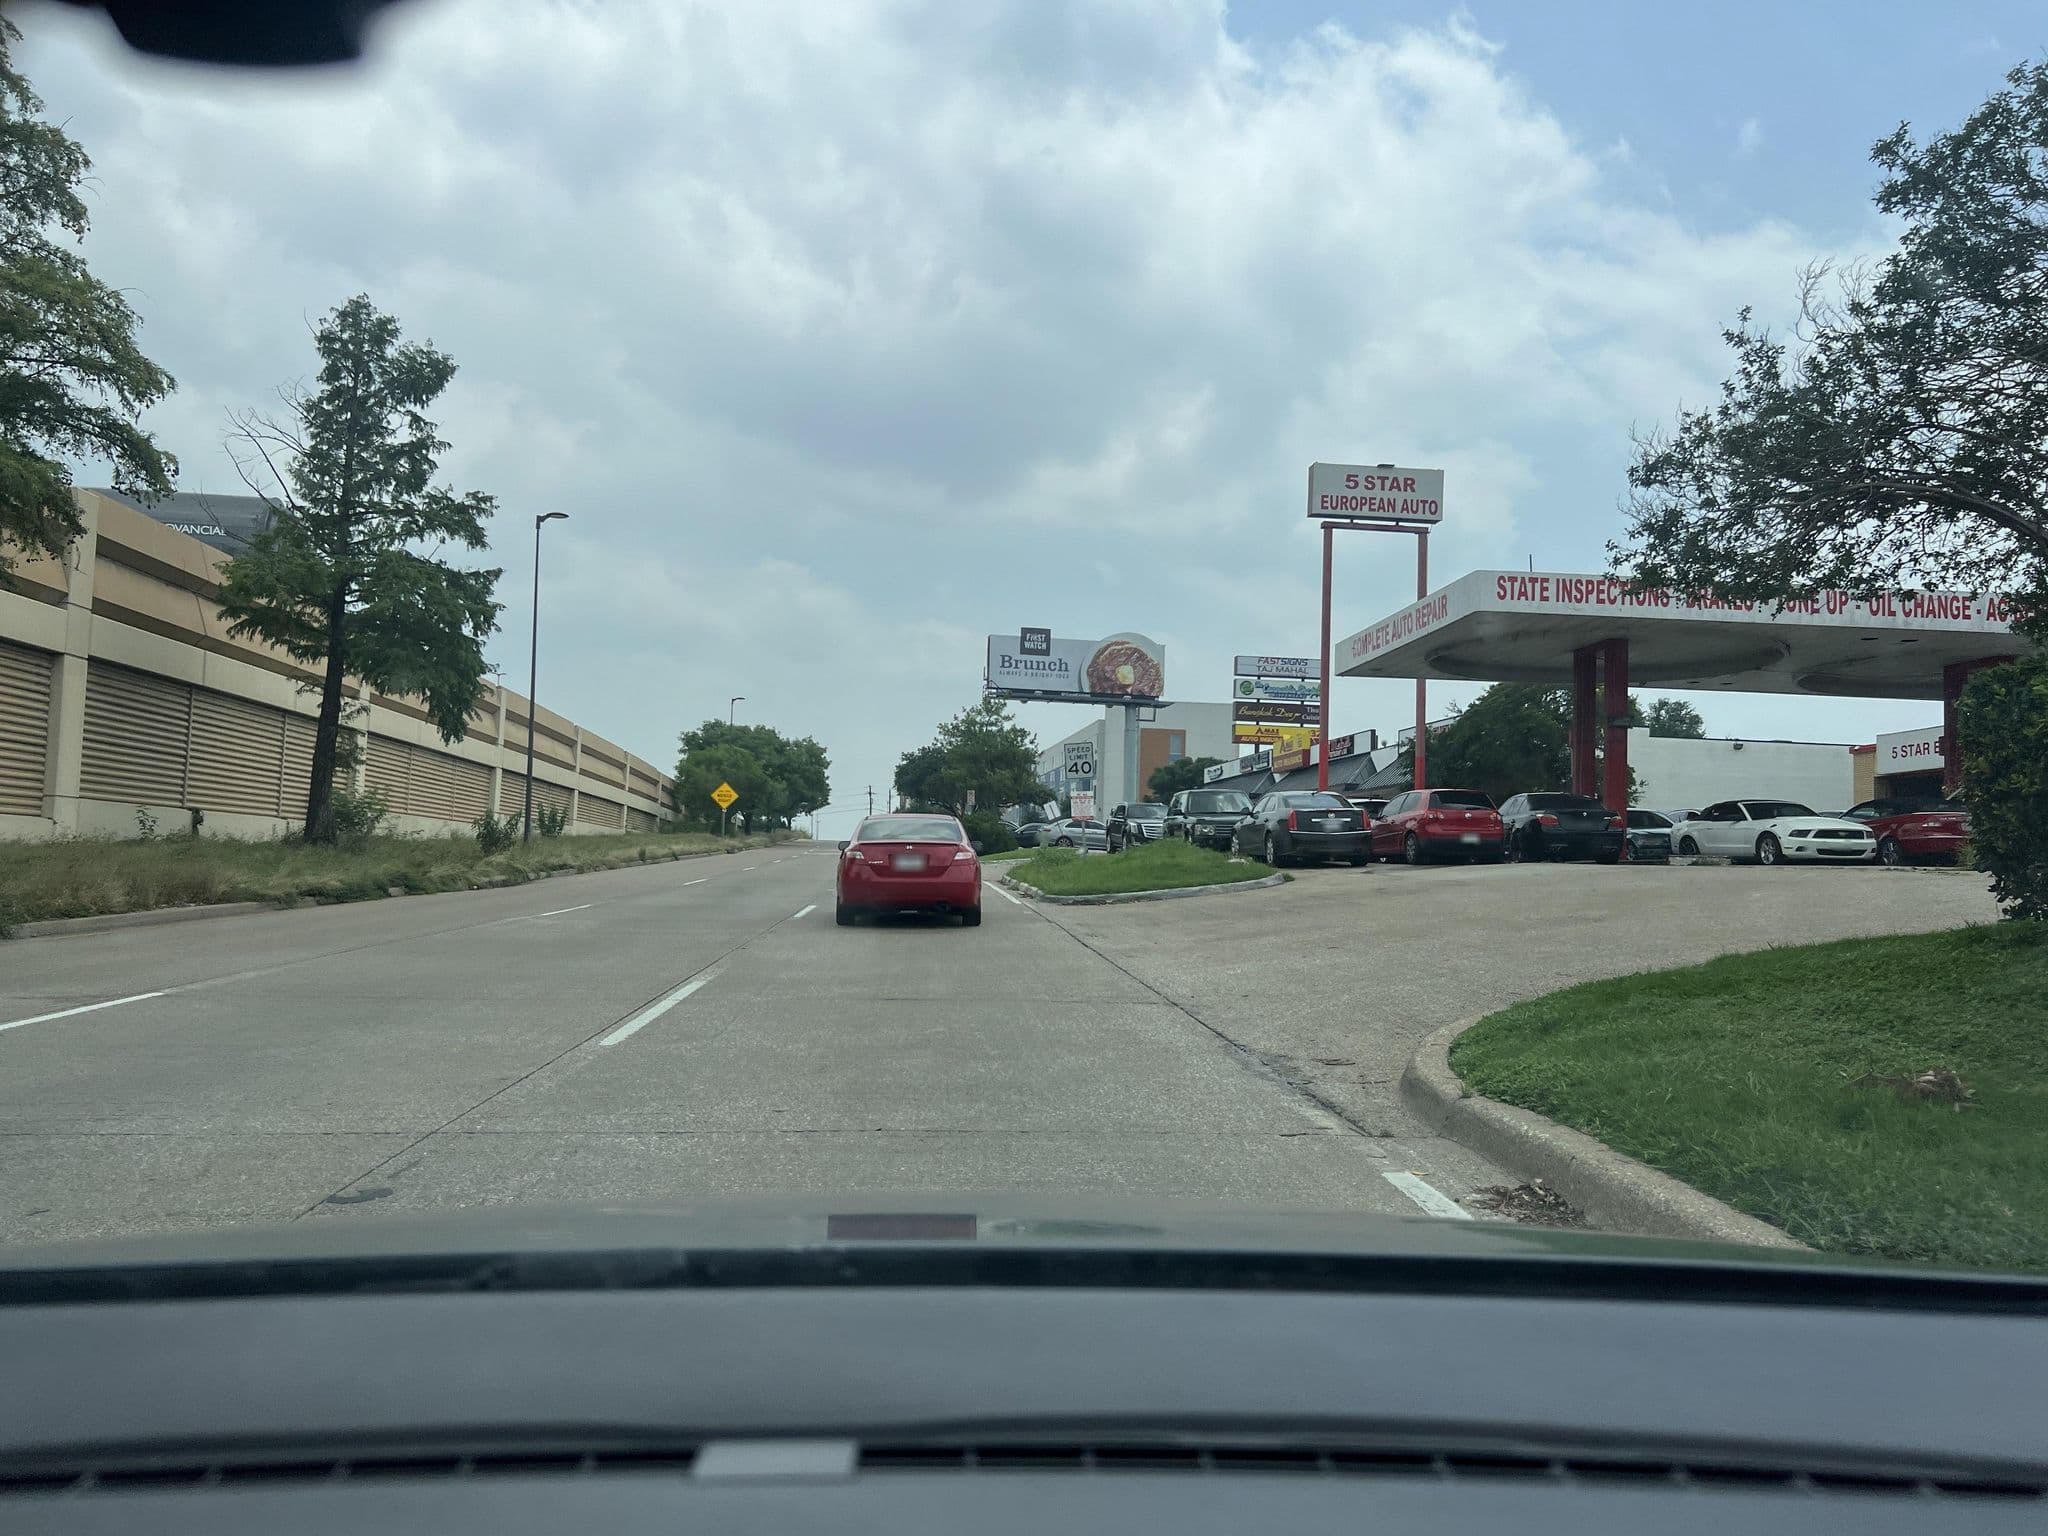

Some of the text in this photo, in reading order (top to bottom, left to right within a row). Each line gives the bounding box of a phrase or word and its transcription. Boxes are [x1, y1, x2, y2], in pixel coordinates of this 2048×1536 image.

[1344, 473, 1416, 493] 5 STAR
[1320, 494, 1439, 516] EUROPEAN AUTO
[1496, 575, 1550, 602] STATE
[1555, 577, 1670, 608] INSPECTIONS
[1826, 590, 1849, 615] UP
[1868, 592, 1897, 617] OIL
[1901, 594, 1972, 621] CHANGE
[1352, 593, 1448, 658] COMPLETE AUTO REPAIR
[1026, 633, 1046, 642] FIRST
[1024, 641, 1047, 650] WATCH
[999, 654, 1070, 672] Brunch
[1257, 657, 1308, 666] FASTSIGNS
[1275, 666, 1309, 675] MAHAL
[1067, 746, 1090, 754] SPEED
[1891, 746, 1898, 759] 5
[1900, 742, 1930, 758] STAR
[1068, 761, 1092, 775] 40
